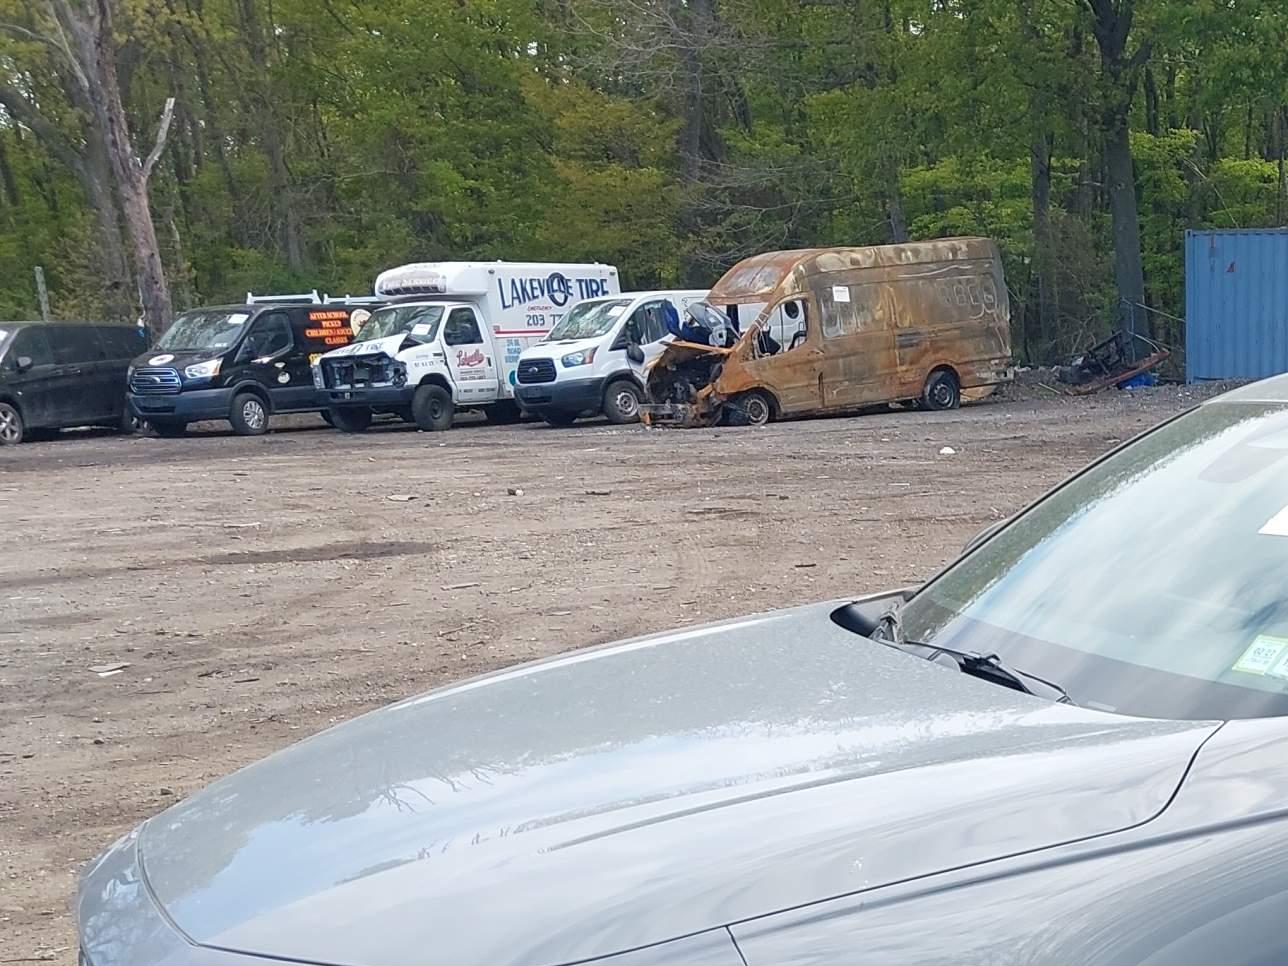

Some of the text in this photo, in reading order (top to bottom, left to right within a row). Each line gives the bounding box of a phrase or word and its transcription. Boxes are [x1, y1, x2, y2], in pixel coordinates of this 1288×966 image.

[497, 277, 609, 311] LAKEVILLE TIRE
[309, 311, 349, 320] AFTER SCHOOL
[525, 314, 545, 326] 203
